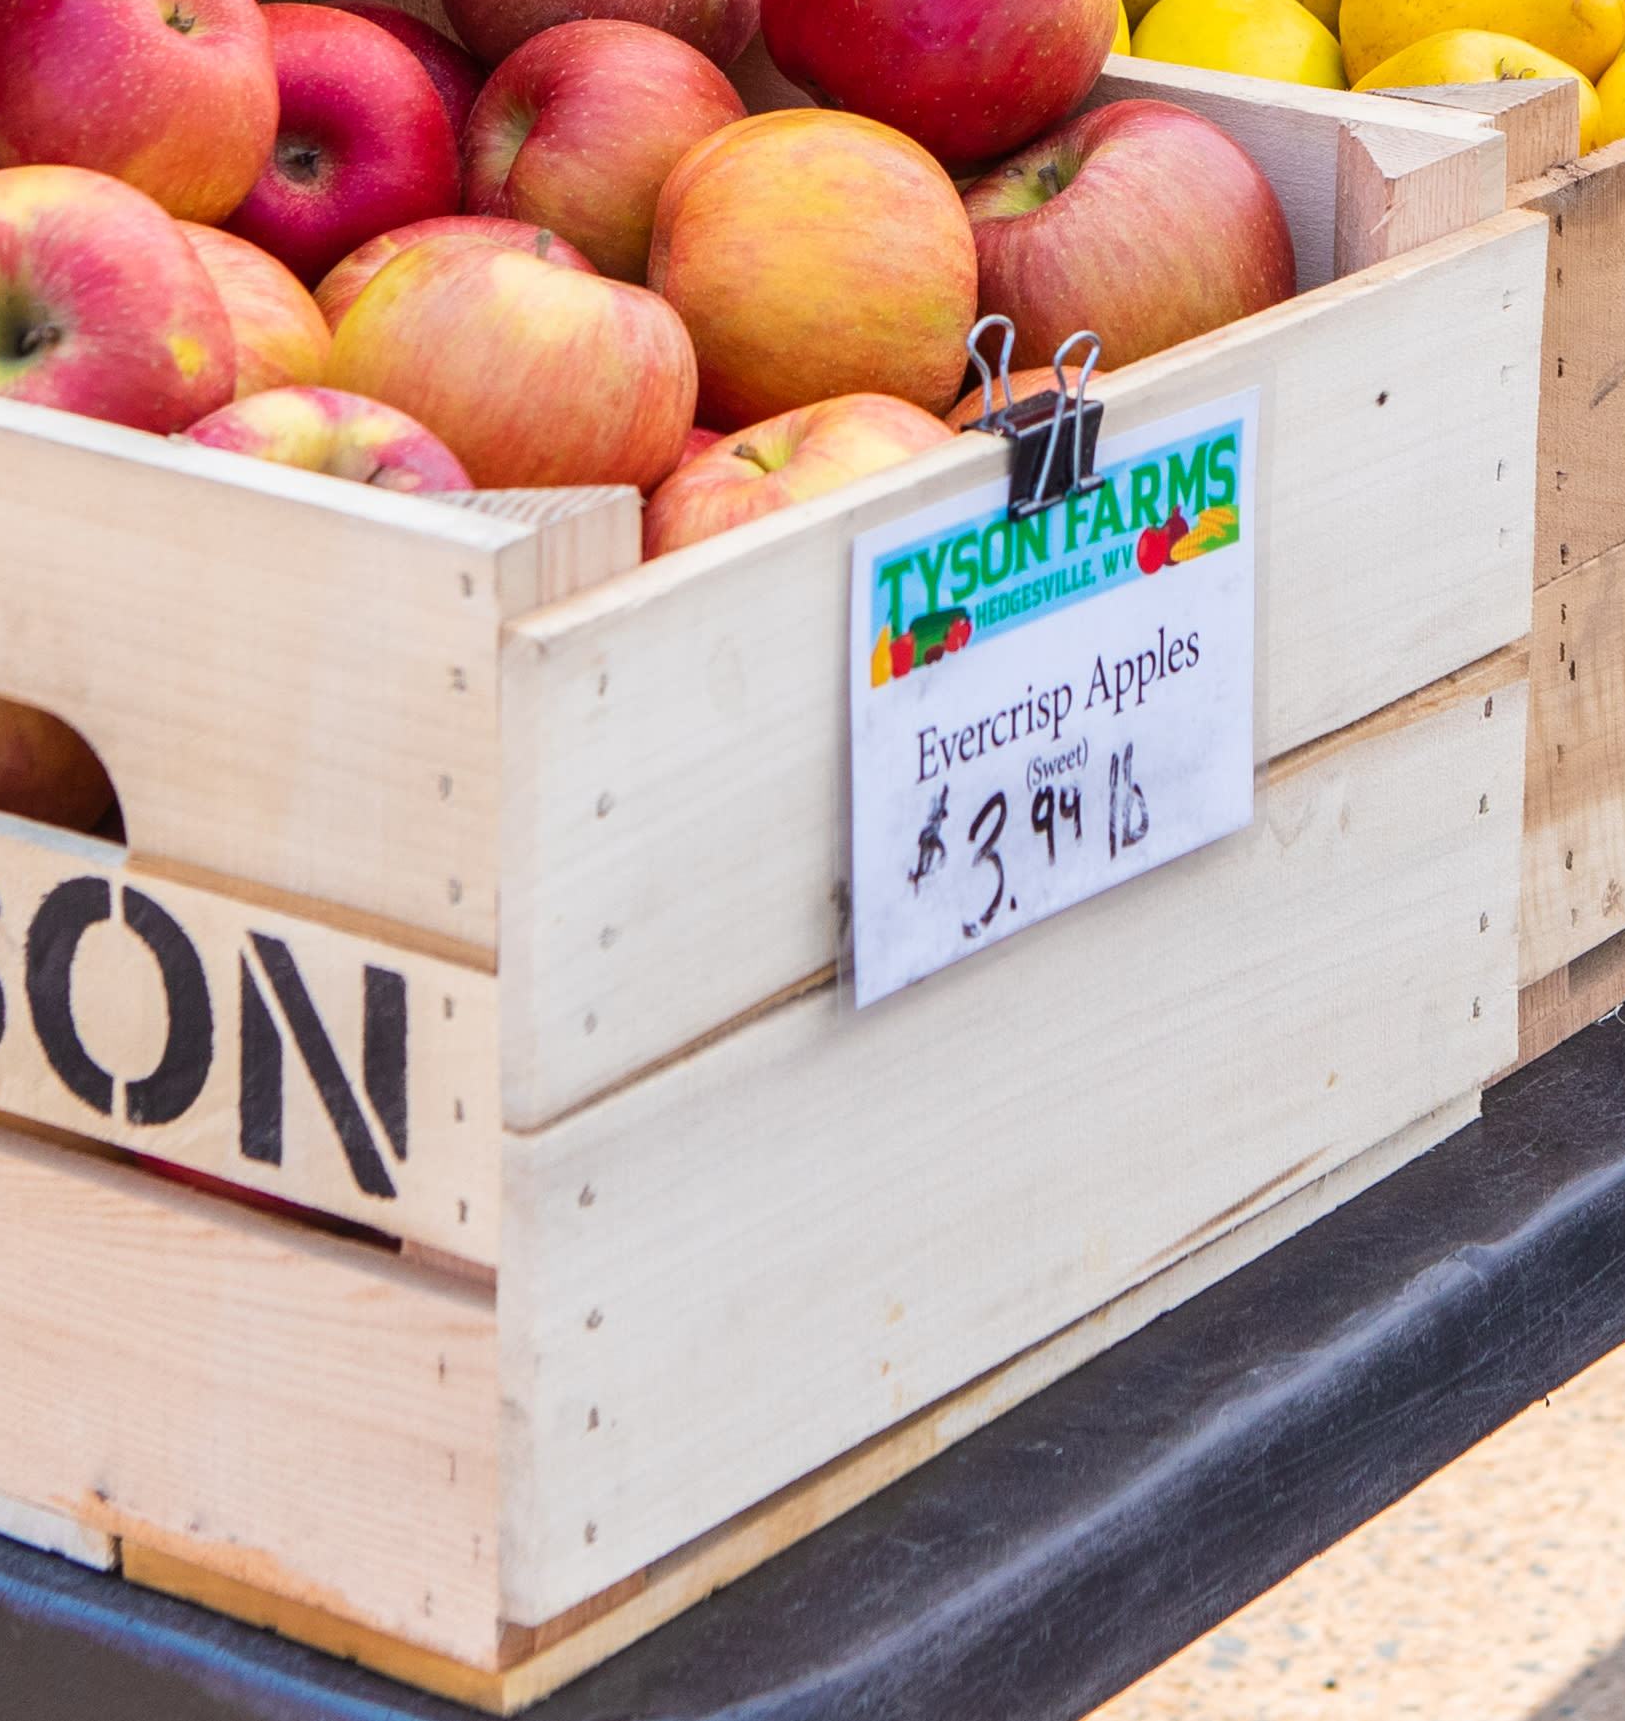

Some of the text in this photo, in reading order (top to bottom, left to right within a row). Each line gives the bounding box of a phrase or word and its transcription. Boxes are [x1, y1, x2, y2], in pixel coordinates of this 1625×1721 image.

[879, 434, 1236, 639] TYSON FARMS
[1103, 543, 1133, 577] WV
[916, 626, 1199, 784] Evercrisp Apples
[1026, 736, 1089, 791] (Sweet)
[1109, 742, 1149, 859] lb
